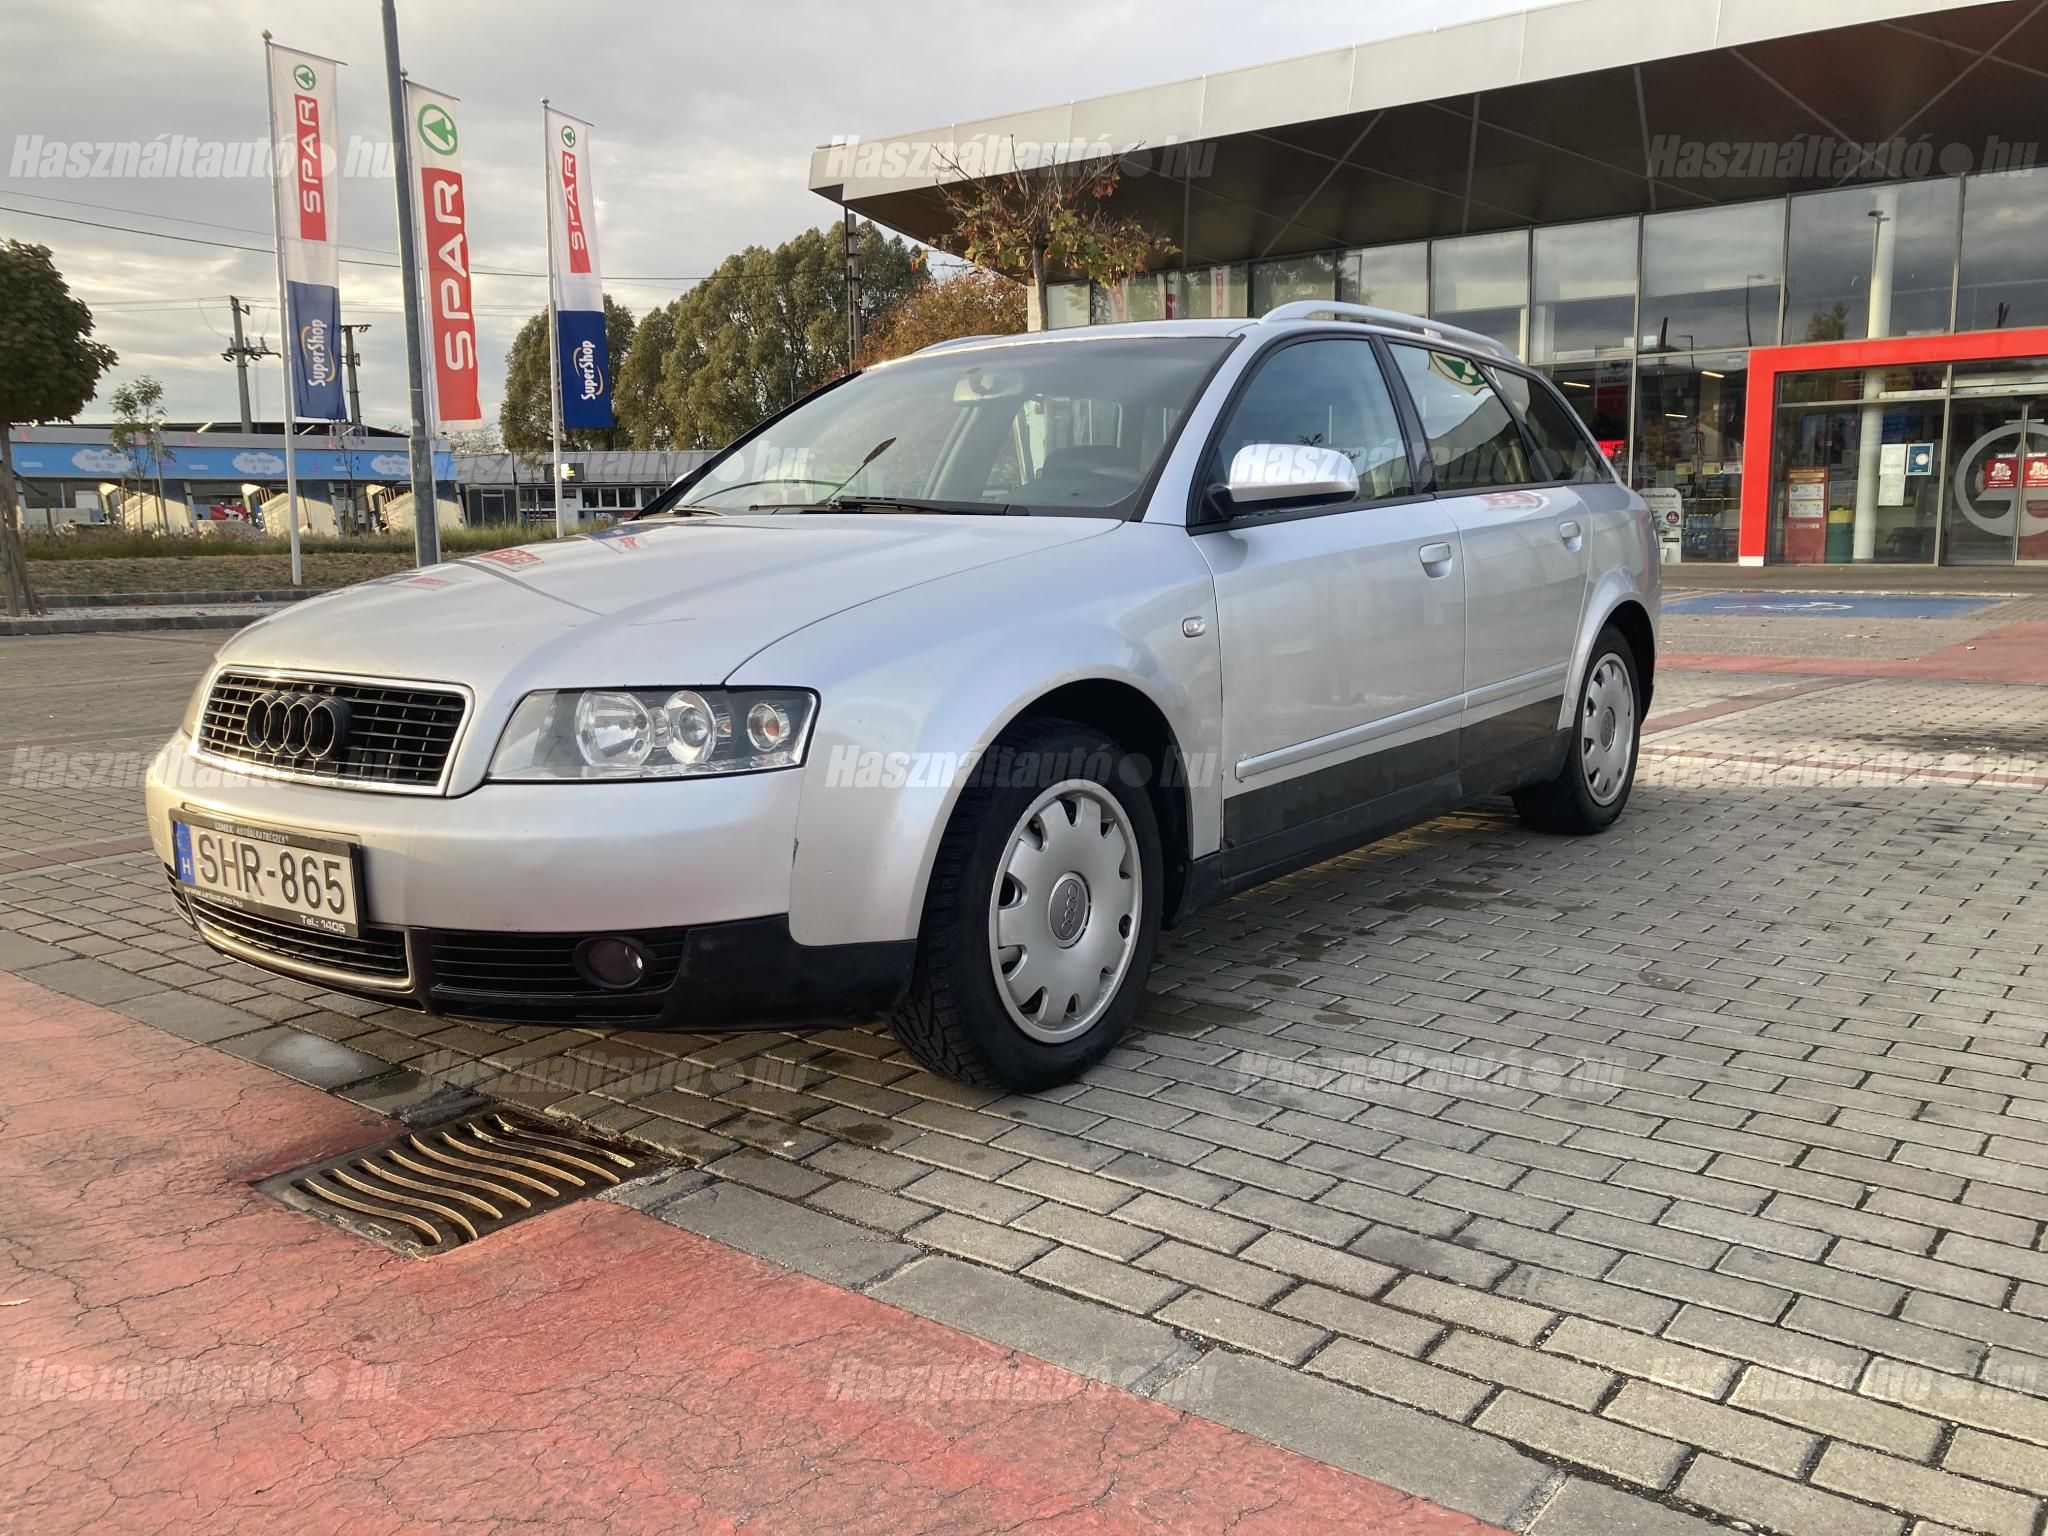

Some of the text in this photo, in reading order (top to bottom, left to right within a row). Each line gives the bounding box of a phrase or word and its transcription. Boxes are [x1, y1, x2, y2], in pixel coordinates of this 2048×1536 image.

[299, 98, 321, 214] SPAR
[433, 179, 474, 371] SPAR
[306, 318, 329, 387] SuperShop
[578, 340, 598, 400] SuperShop
[182, 857, 192, 876] H
[198, 831, 345, 915] SHR-865
[320, 919, 346, 933] 1405
